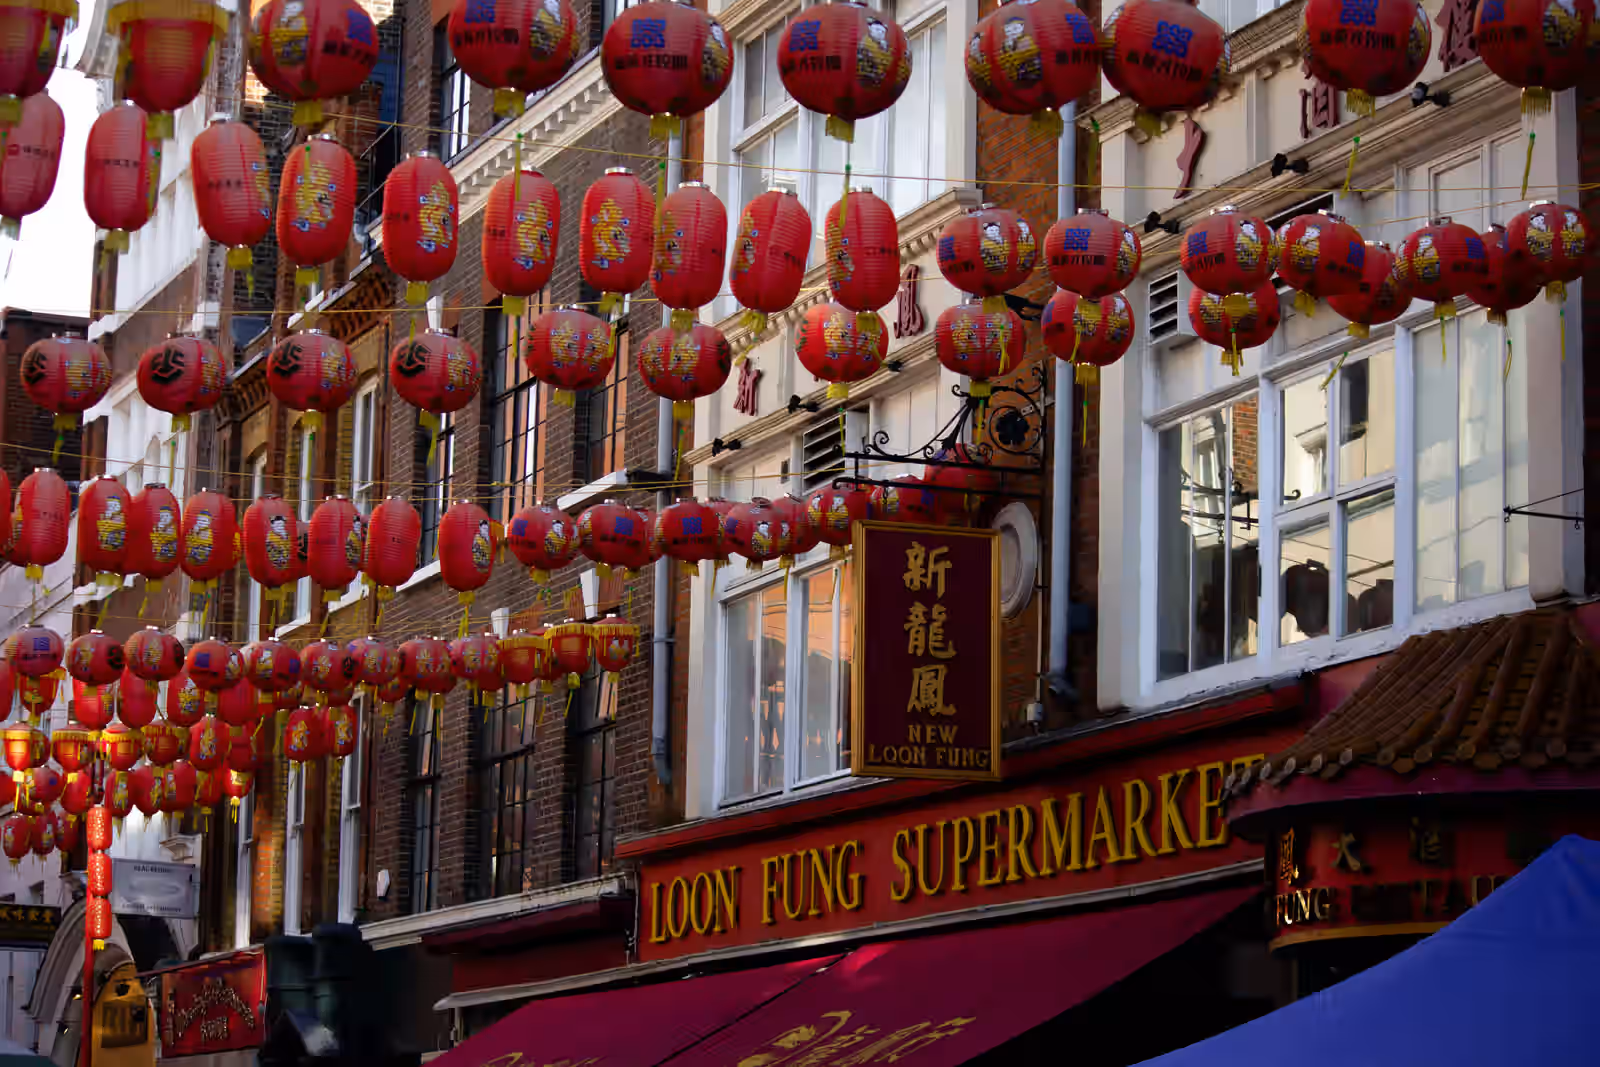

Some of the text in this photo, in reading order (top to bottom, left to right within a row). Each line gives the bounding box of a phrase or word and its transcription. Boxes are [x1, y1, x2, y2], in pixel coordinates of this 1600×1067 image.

[903, 541, 958, 718] 新龍鳳
[908, 724, 959, 745] NEW
[868, 744, 992, 768] LOON FUNG
[649, 865, 738, 943] LOON
[761, 840, 861, 924] FUNG
[1276, 887, 1331, 927] FUNG
